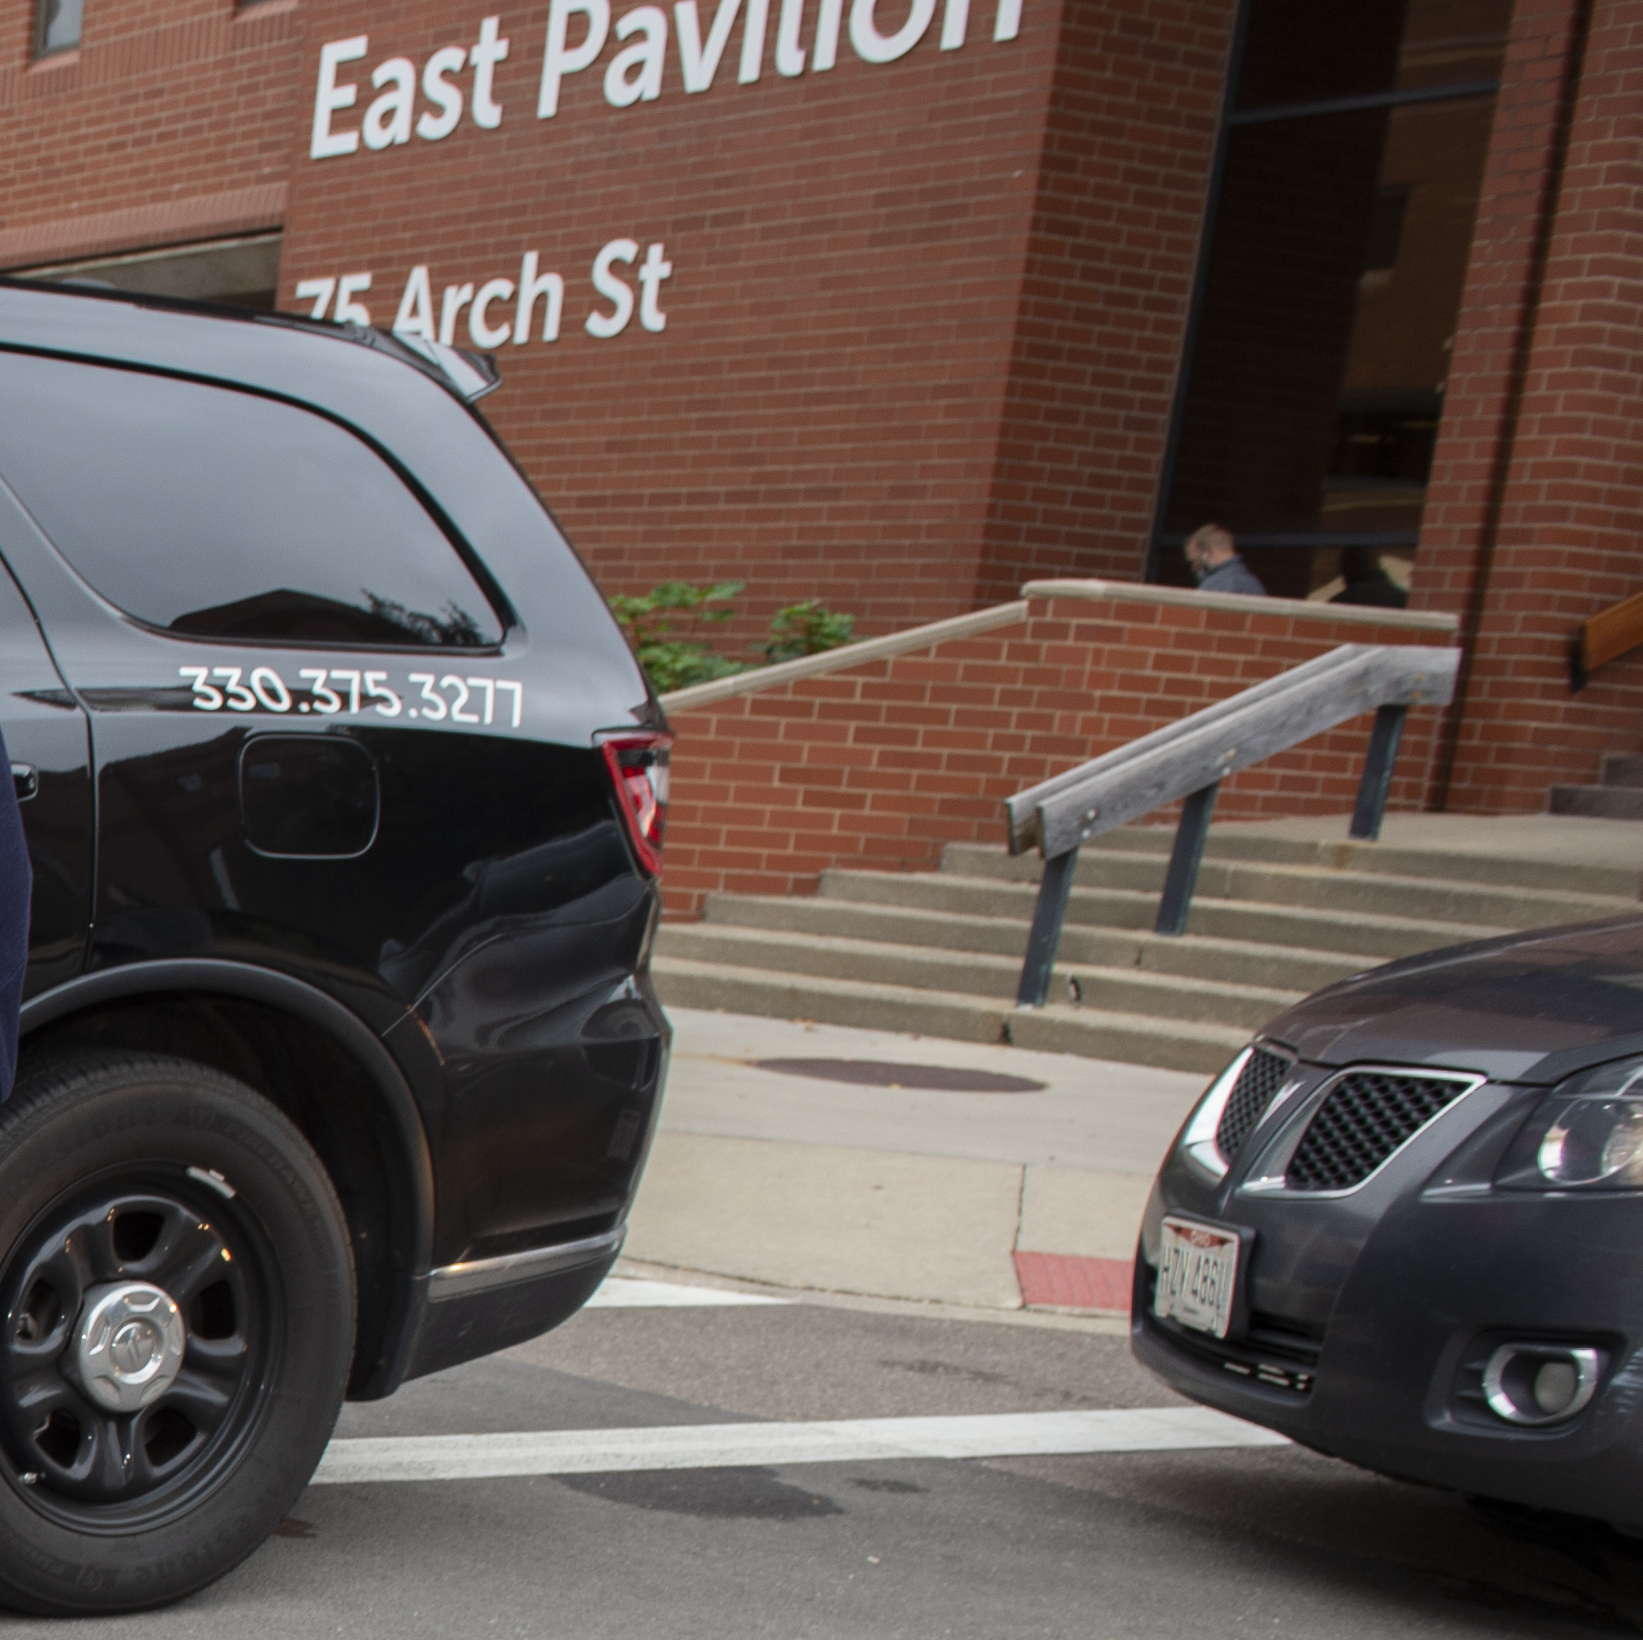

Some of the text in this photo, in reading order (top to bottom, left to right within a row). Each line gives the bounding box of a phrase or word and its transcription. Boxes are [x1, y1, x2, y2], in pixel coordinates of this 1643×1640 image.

[309, 16, 509, 160] East
[392, 250, 564, 349] Arch
[585, 238, 672, 338] St
[178, 666, 523, 727] 330.375.3277
